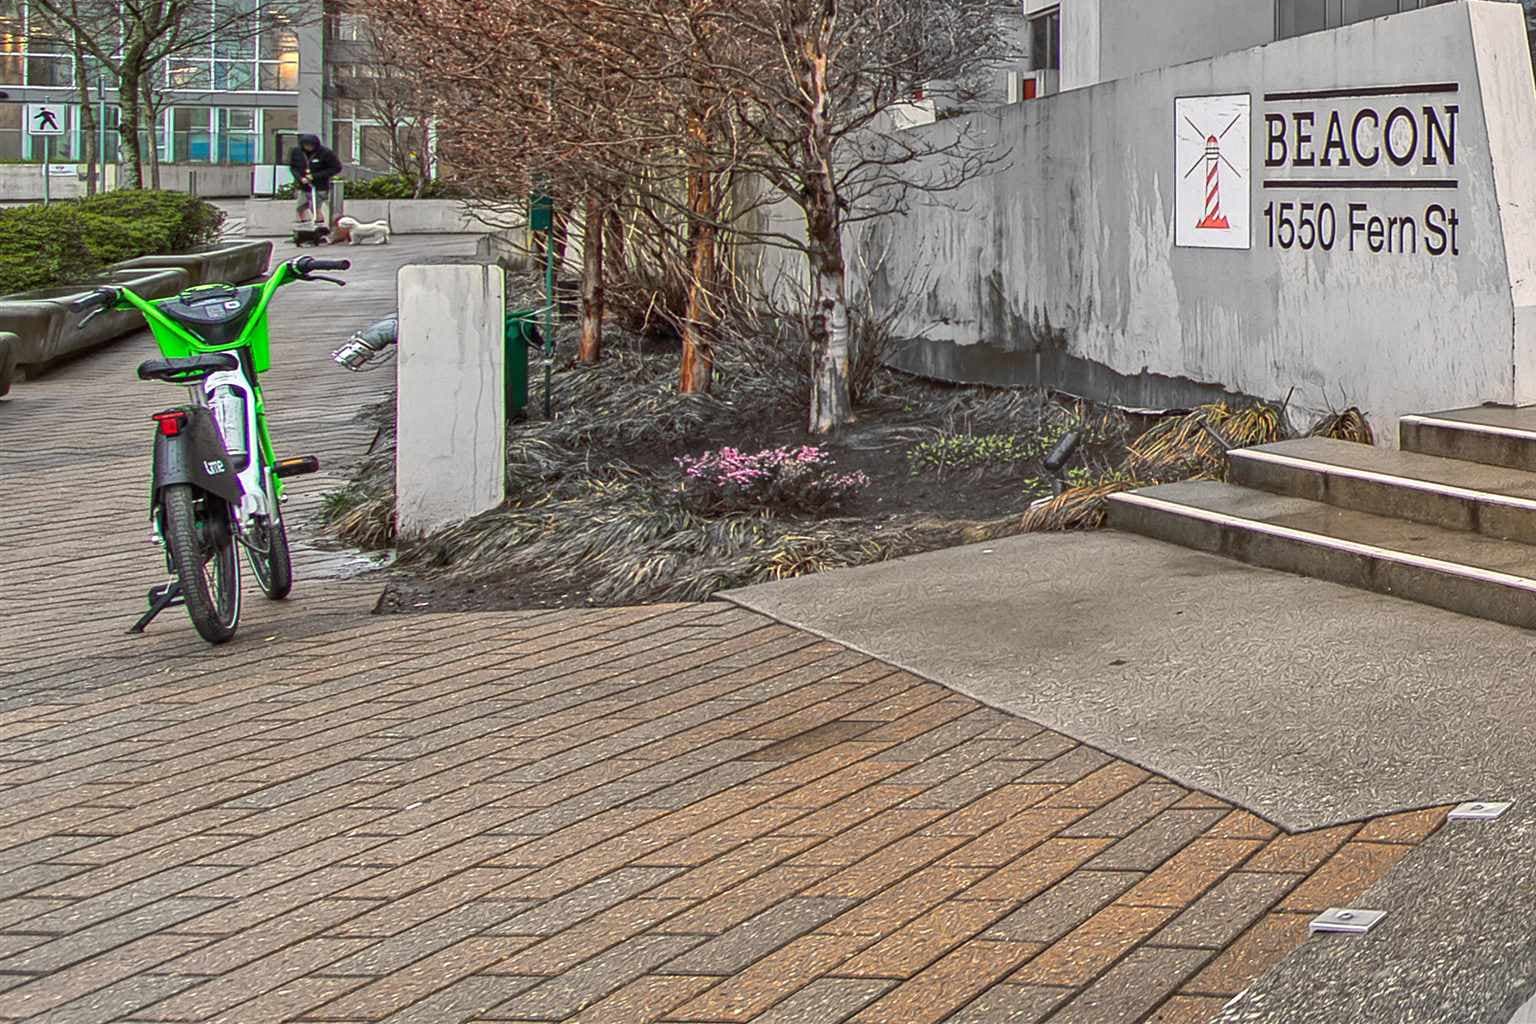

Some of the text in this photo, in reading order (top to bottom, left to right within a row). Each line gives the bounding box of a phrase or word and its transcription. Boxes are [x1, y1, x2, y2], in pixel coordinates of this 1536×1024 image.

[1264, 105, 1459, 168] BEACON
[1264, 200, 1459, 256] 1550 Fern St
